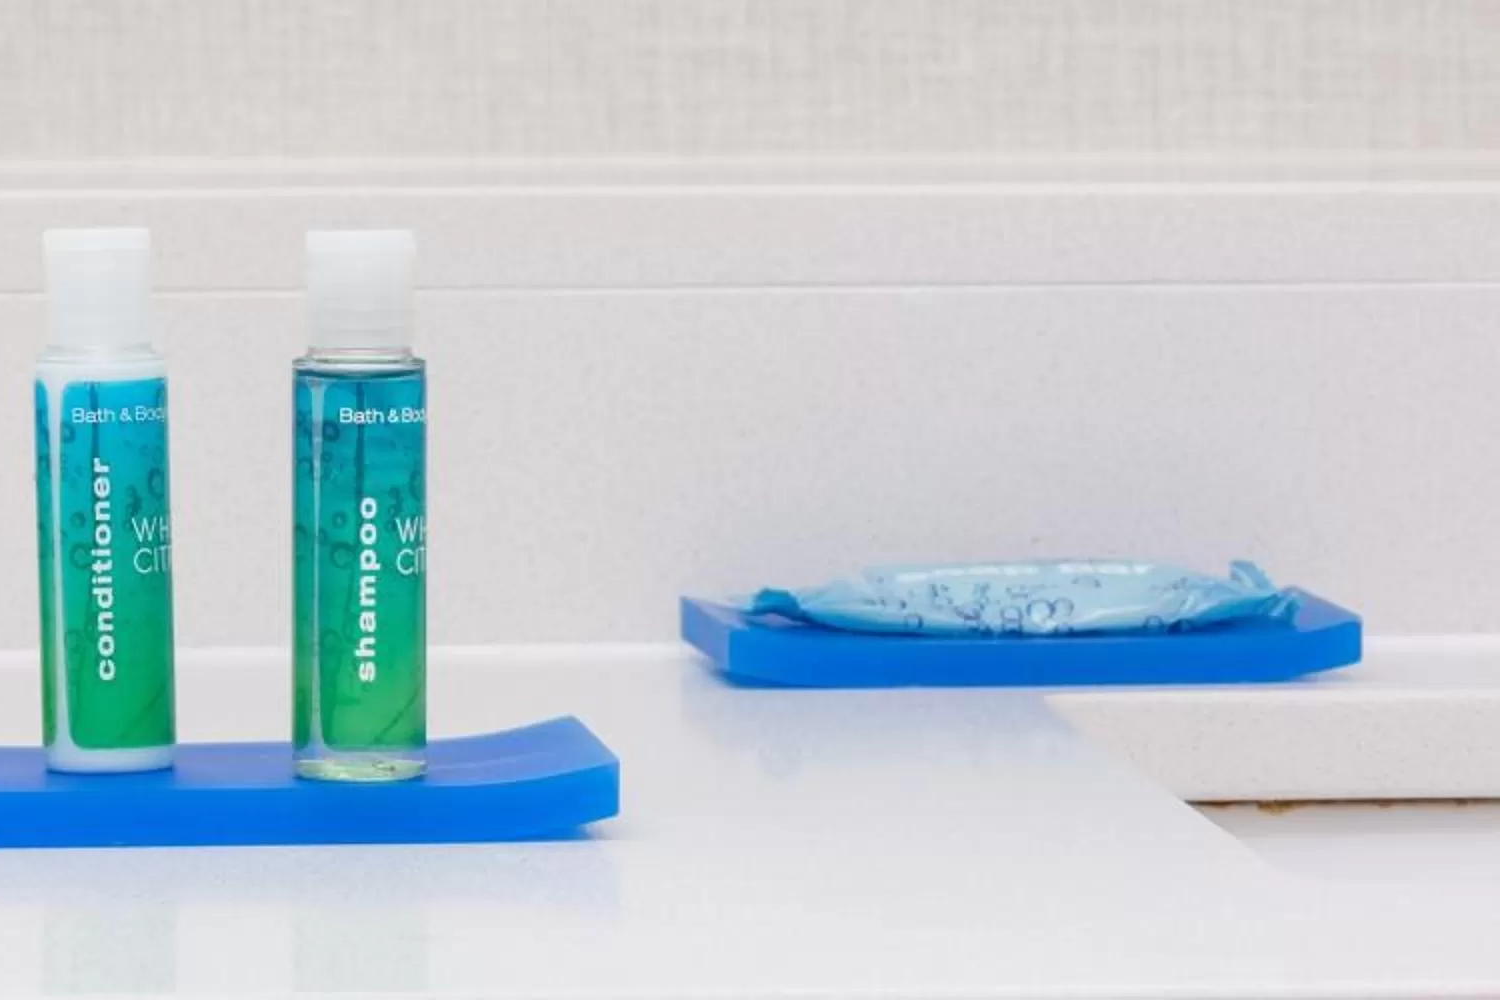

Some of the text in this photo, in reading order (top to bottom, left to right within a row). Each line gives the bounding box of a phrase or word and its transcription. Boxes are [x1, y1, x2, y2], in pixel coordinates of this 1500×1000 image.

[71, 407, 116, 423] Bath
[118, 407, 132, 422] &
[339, 407, 385, 424] Bath
[387, 409, 399, 424] &
[91, 457, 116, 681] conditioner
[354, 497, 381, 683] shampoo
